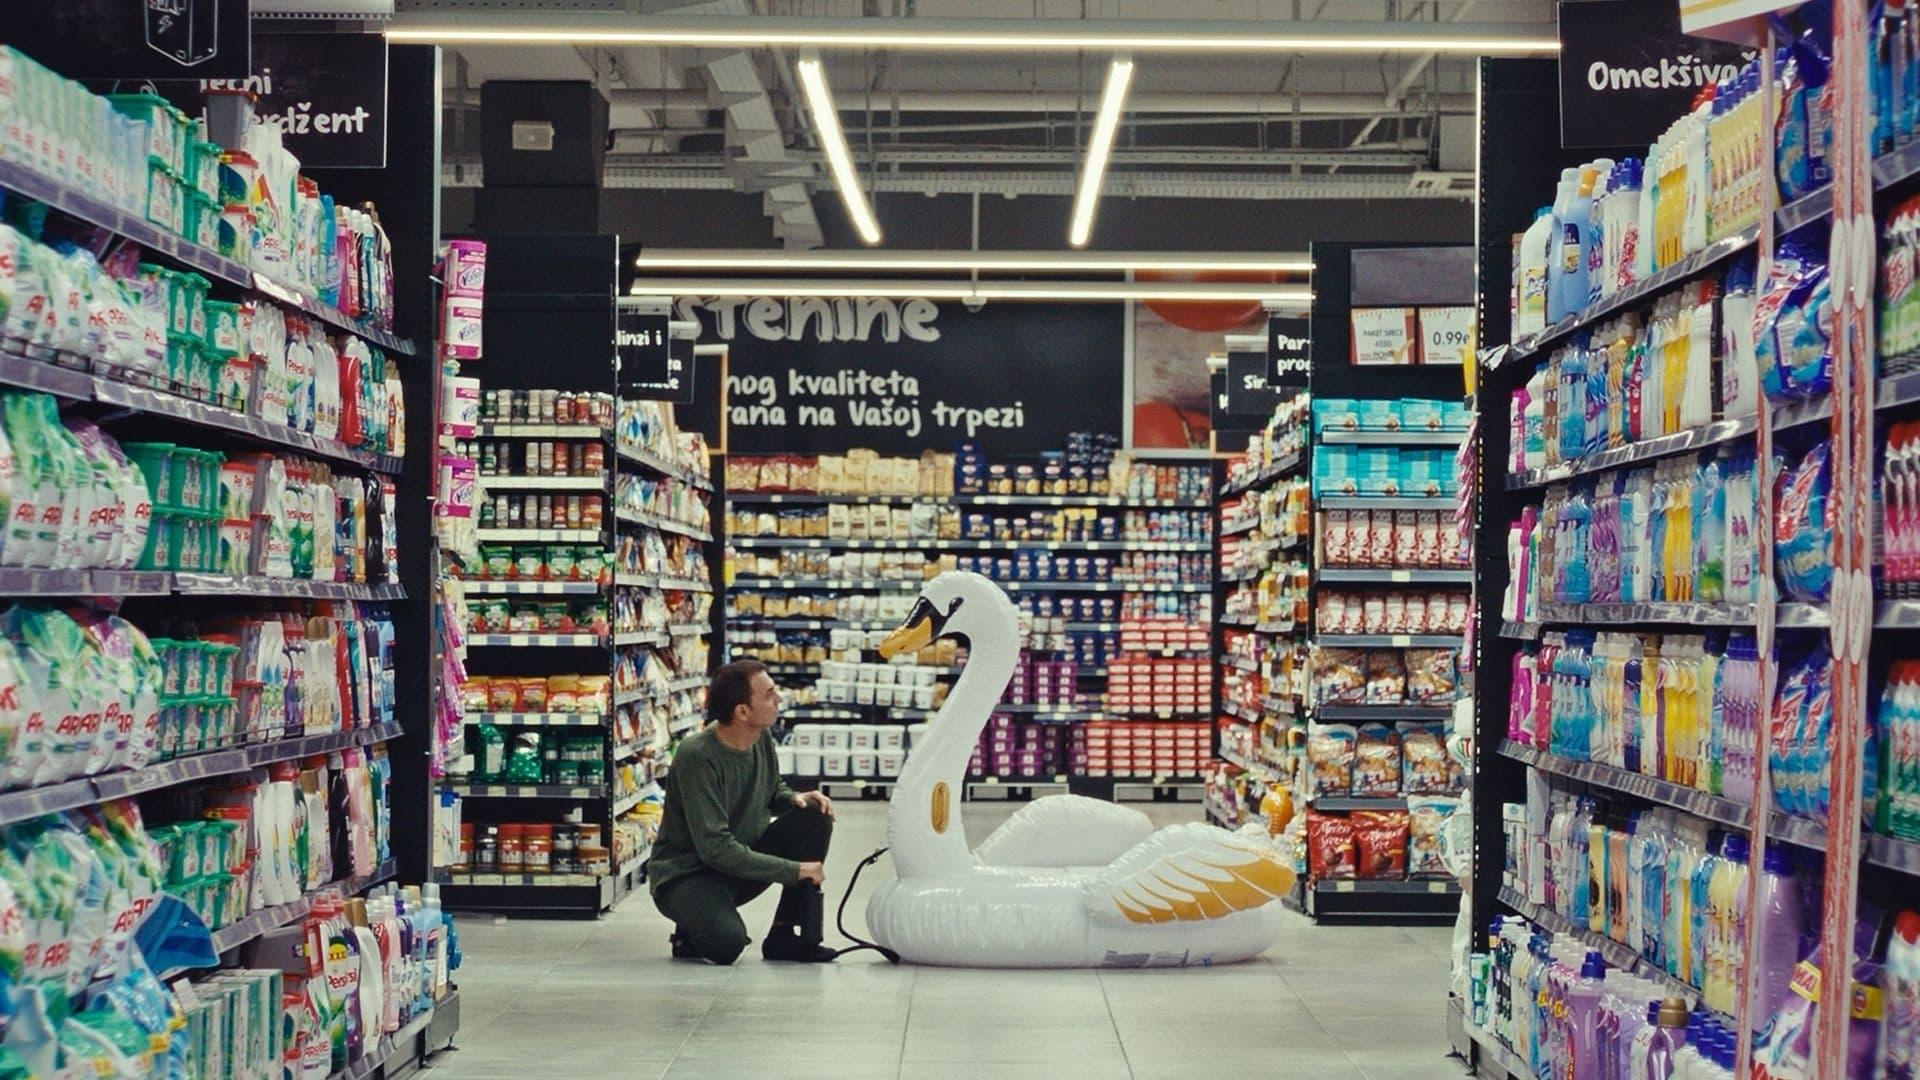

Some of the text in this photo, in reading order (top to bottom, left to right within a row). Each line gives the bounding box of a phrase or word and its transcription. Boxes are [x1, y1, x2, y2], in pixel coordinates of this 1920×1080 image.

[655, 330, 663, 346] i
[788, 368, 919, 397] kvaliteta
[798, 405, 836, 426] na
[848, 397, 922, 438] Vašoj
[931, 400, 1024, 437] trpezi
